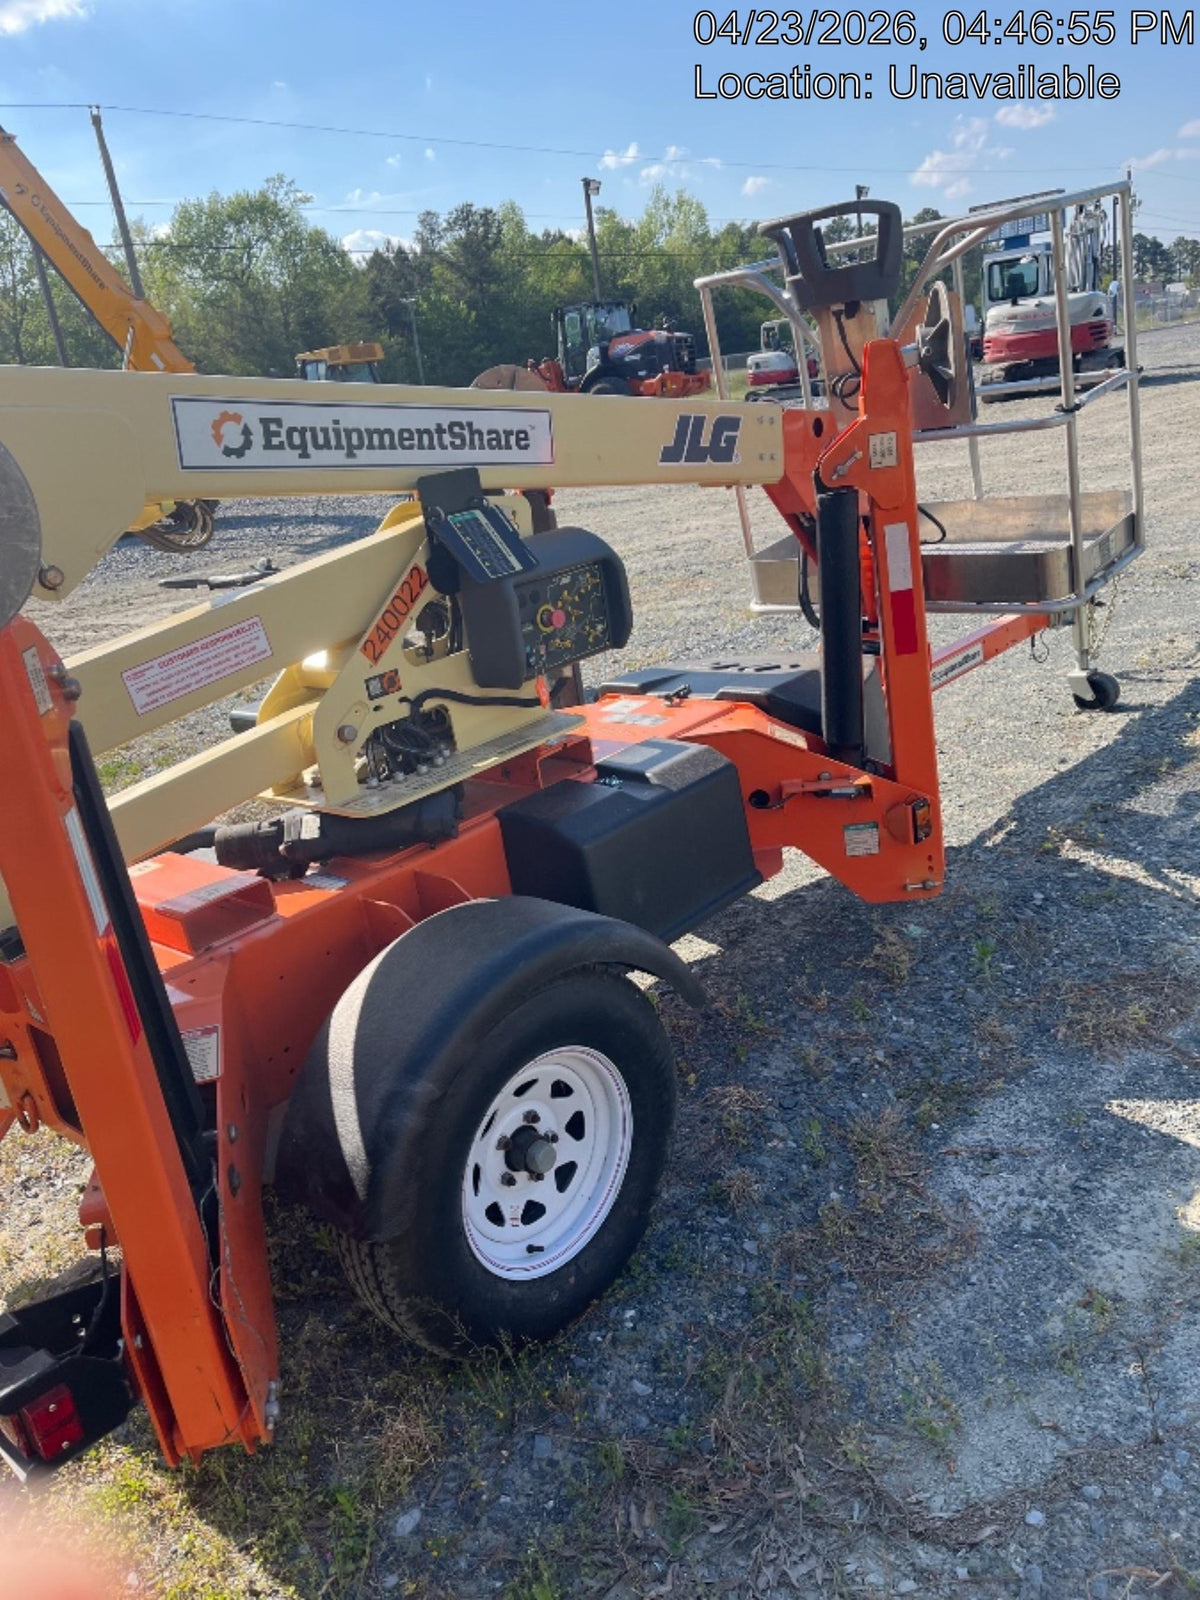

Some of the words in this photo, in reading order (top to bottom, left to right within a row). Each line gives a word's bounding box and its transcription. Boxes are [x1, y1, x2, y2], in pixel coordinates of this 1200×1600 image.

[259, 417, 530, 459] EquipmentShare
[659, 414, 742, 463] JLG
[363, 566, 428, 663] 240022
